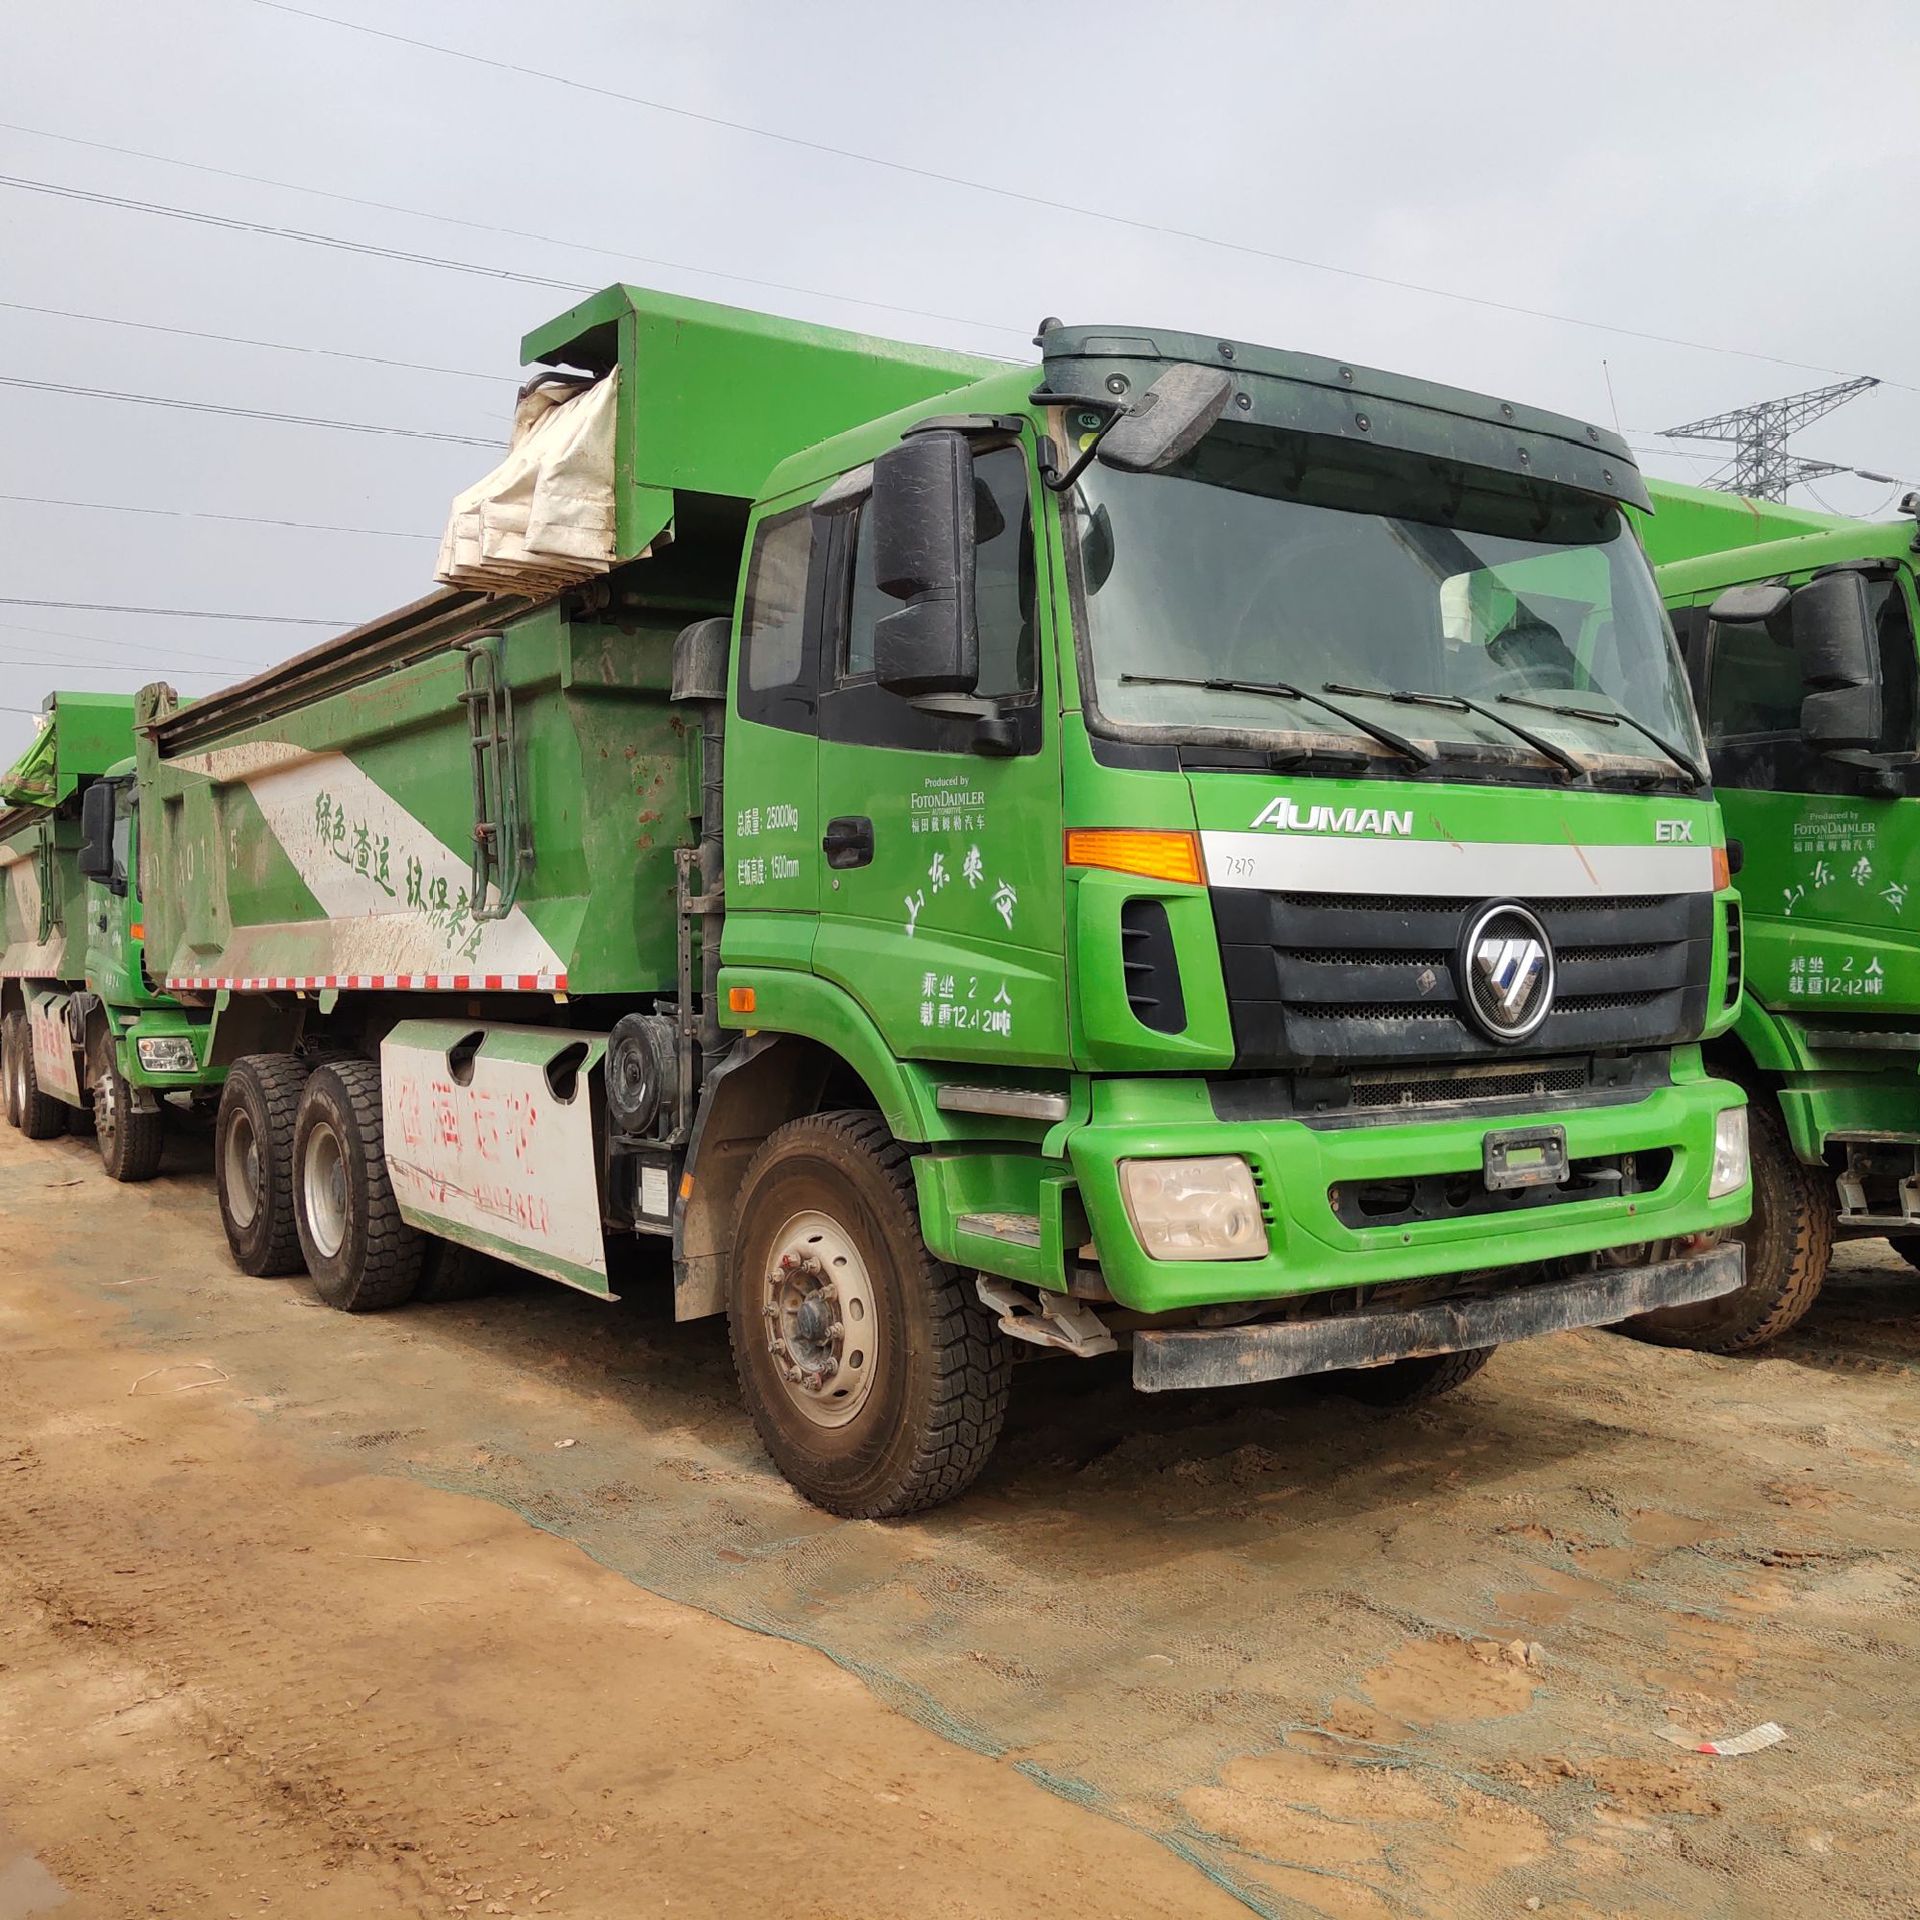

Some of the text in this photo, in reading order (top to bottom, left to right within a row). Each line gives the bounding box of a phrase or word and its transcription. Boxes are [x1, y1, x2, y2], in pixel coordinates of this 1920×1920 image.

[925, 775, 970, 788] Produced by
[911, 790, 985, 809] FOTONDAIMLER
[1248, 797, 1414, 836] AUMAN
[1809, 811, 1859, 821] Produced by
[1656, 819, 1693, 843] ETX
[1842, 956, 1853, 972] 2
[1864, 956, 1884, 975] 人
[967, 976, 978, 998] 2
[993, 978, 1013, 1006] 人
